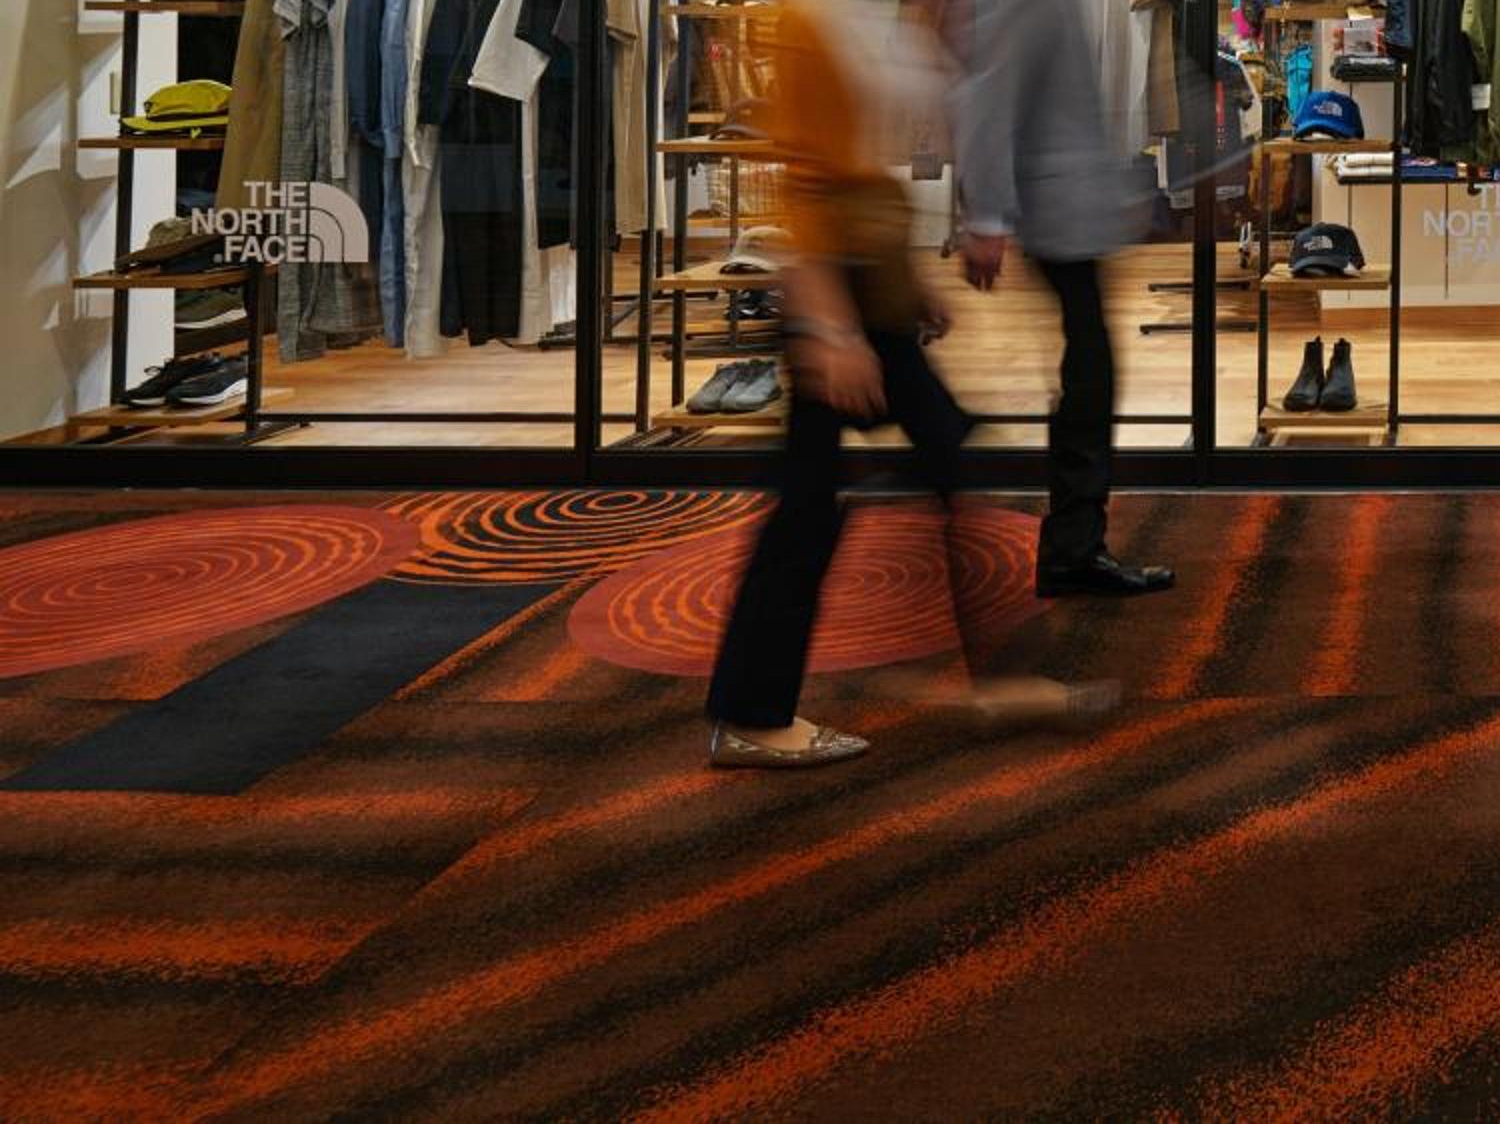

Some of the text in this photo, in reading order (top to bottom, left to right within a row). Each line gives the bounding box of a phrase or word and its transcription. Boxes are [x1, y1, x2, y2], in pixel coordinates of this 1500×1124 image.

[243, 181, 307, 207] THE
[191, 208, 307, 235] NORTH
[224, 235, 307, 263] FACE
